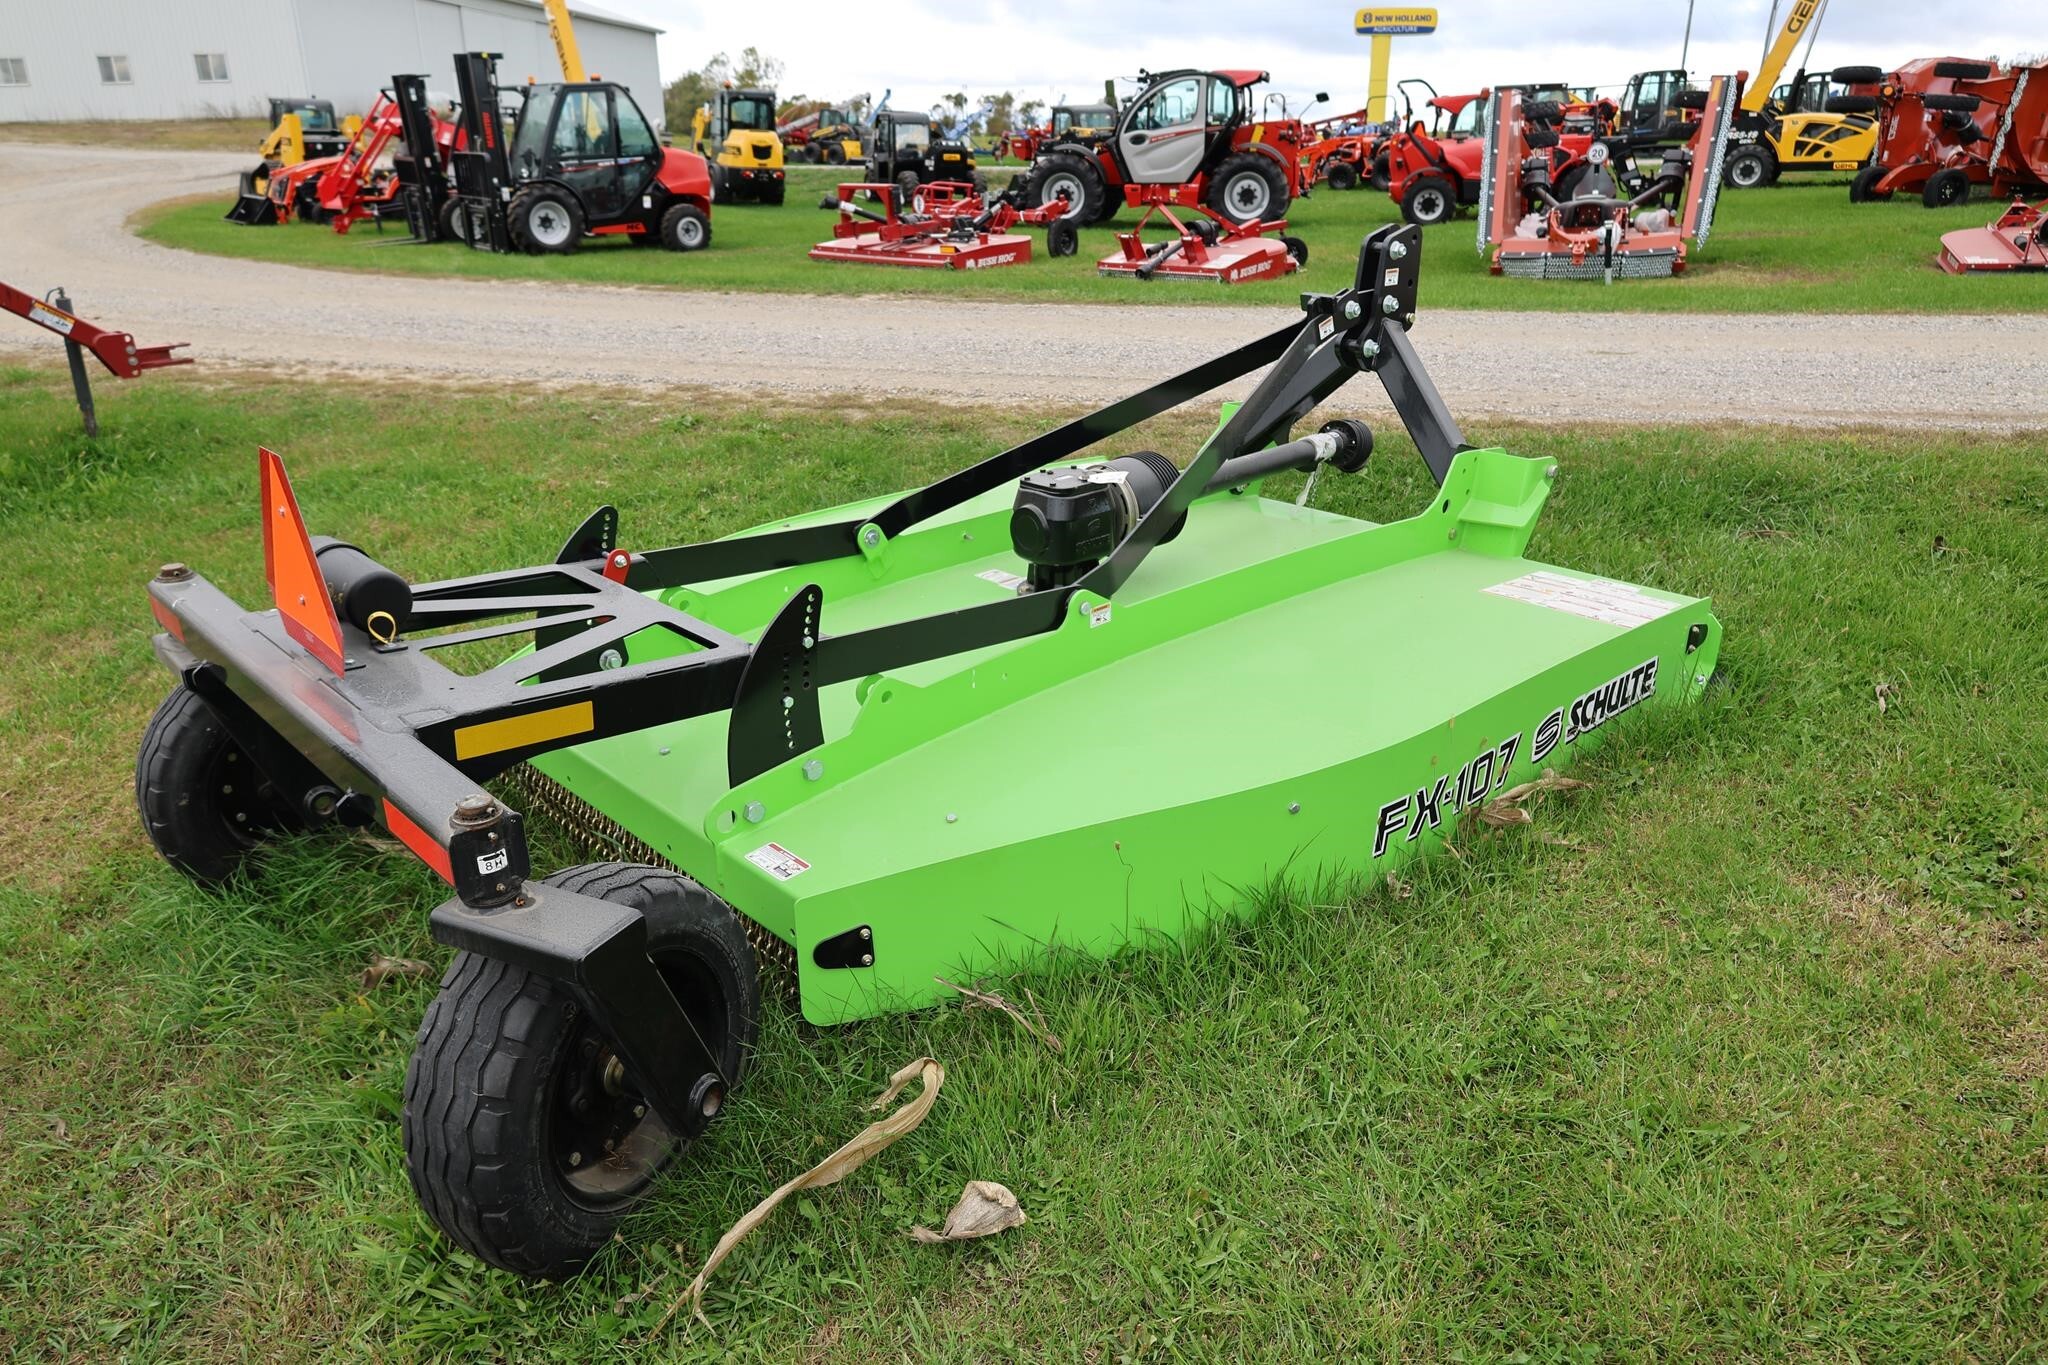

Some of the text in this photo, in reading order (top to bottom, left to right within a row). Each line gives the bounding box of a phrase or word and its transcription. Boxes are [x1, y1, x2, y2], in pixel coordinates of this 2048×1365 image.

[1394, 14, 1432, 22] HOLLAND
[1372, 25, 1418, 33] AGRICULTURE
[1591, 149, 1604, 158] 20
[977, 252, 1016, 268] BUSH HOG
[1240, 259, 1273, 278] BUSH HOG
[1565, 656, 1658, 745] SCHULTE
[1372, 731, 1522, 859] FX-107
